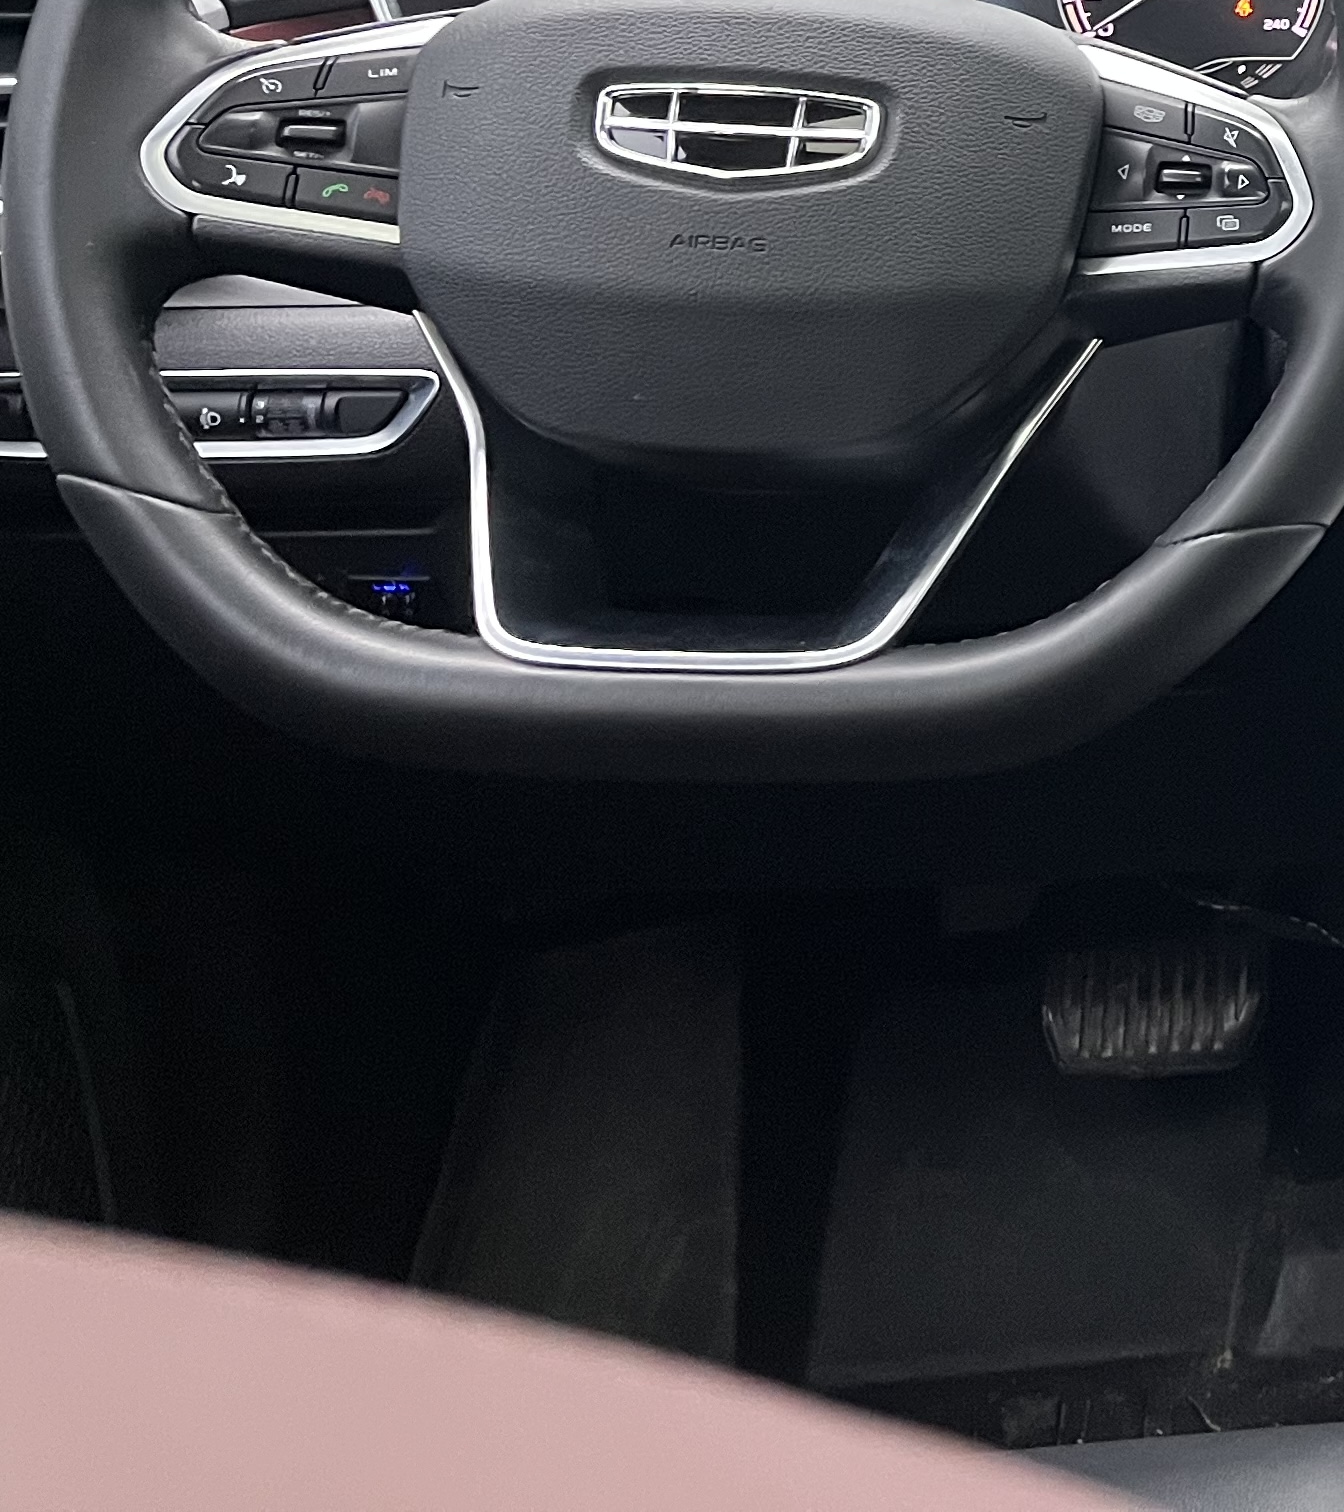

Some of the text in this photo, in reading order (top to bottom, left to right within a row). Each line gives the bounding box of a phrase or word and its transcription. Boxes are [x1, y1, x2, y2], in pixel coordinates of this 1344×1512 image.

[1263, 18, 1290, 32] 240
[367, 67, 398, 78] LIM
[1111, 223, 1153, 233] MODE
[668, 233, 768, 252] AIRBAG
